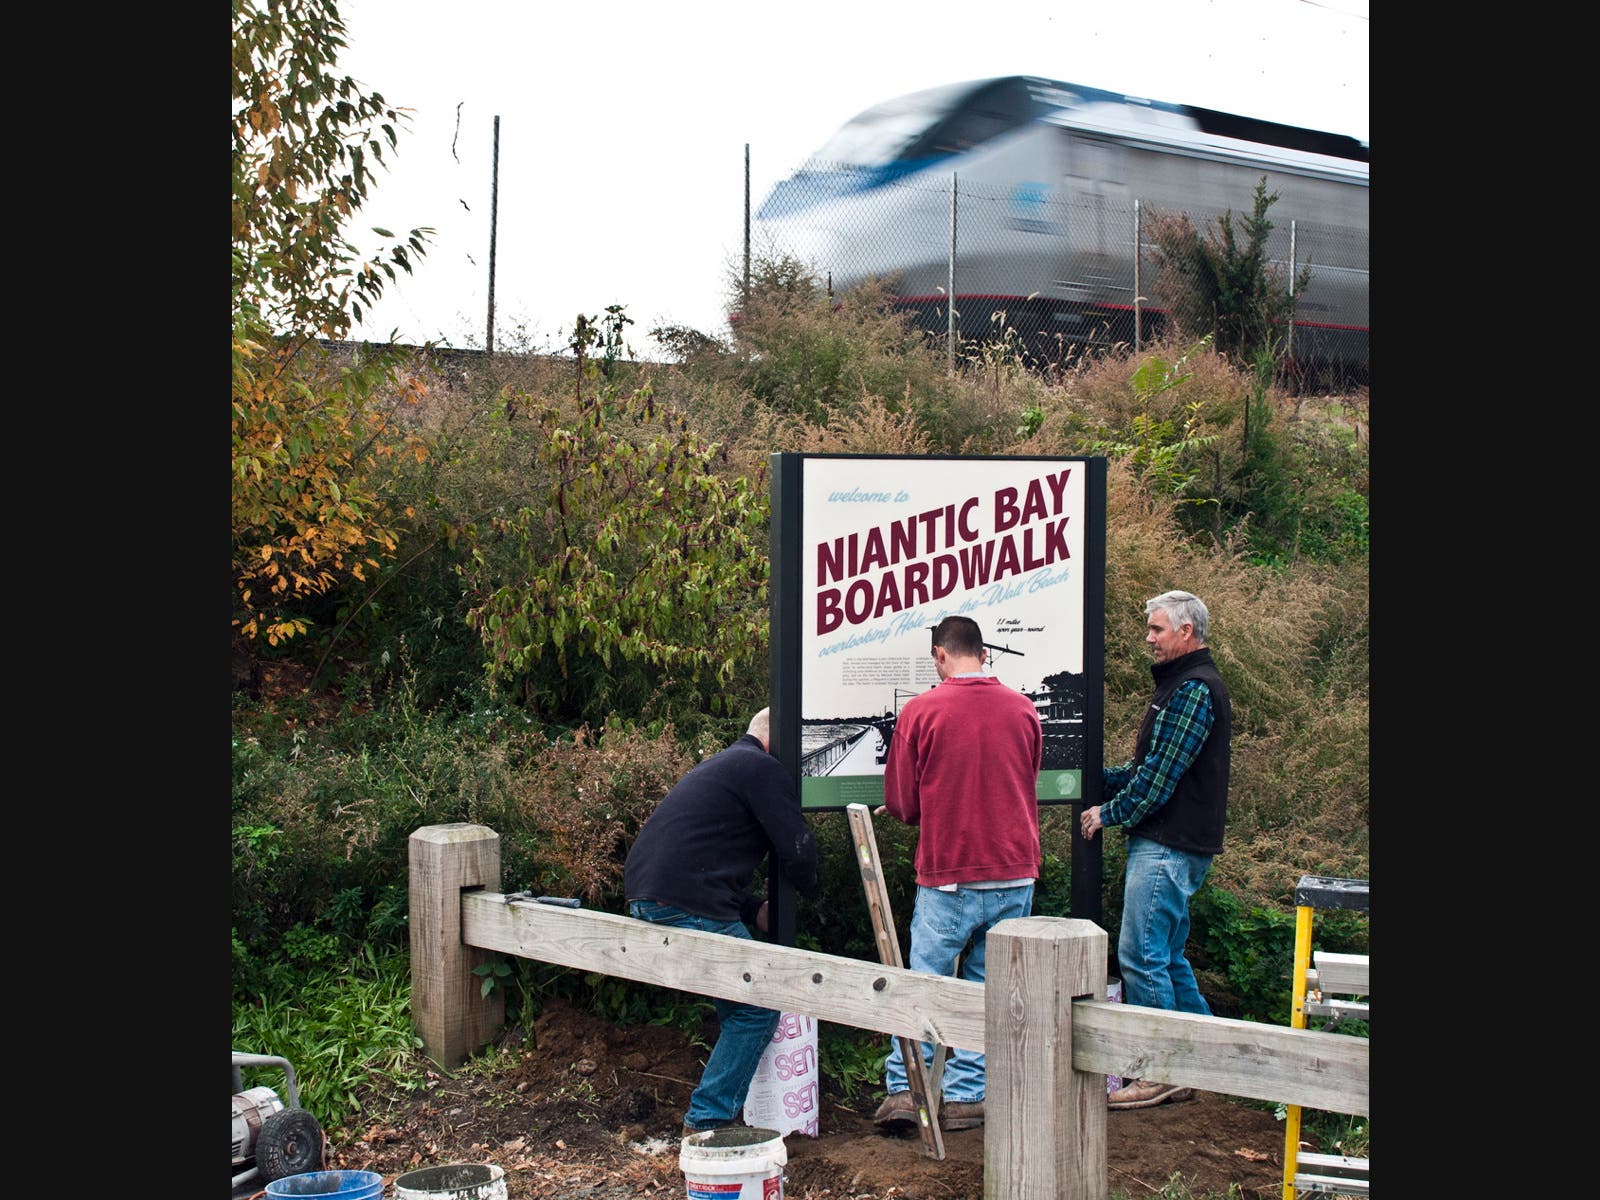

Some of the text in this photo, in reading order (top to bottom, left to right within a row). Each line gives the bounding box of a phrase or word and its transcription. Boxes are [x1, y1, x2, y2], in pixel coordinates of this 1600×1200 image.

[817, 468, 1071, 587] NIANTIC BAY
[828, 486, 910, 502] welcome to
[817, 516, 1071, 636] BOARDWALK
[818, 625, 892, 658] overlooking
[1025, 567, 1070, 594] Beach
